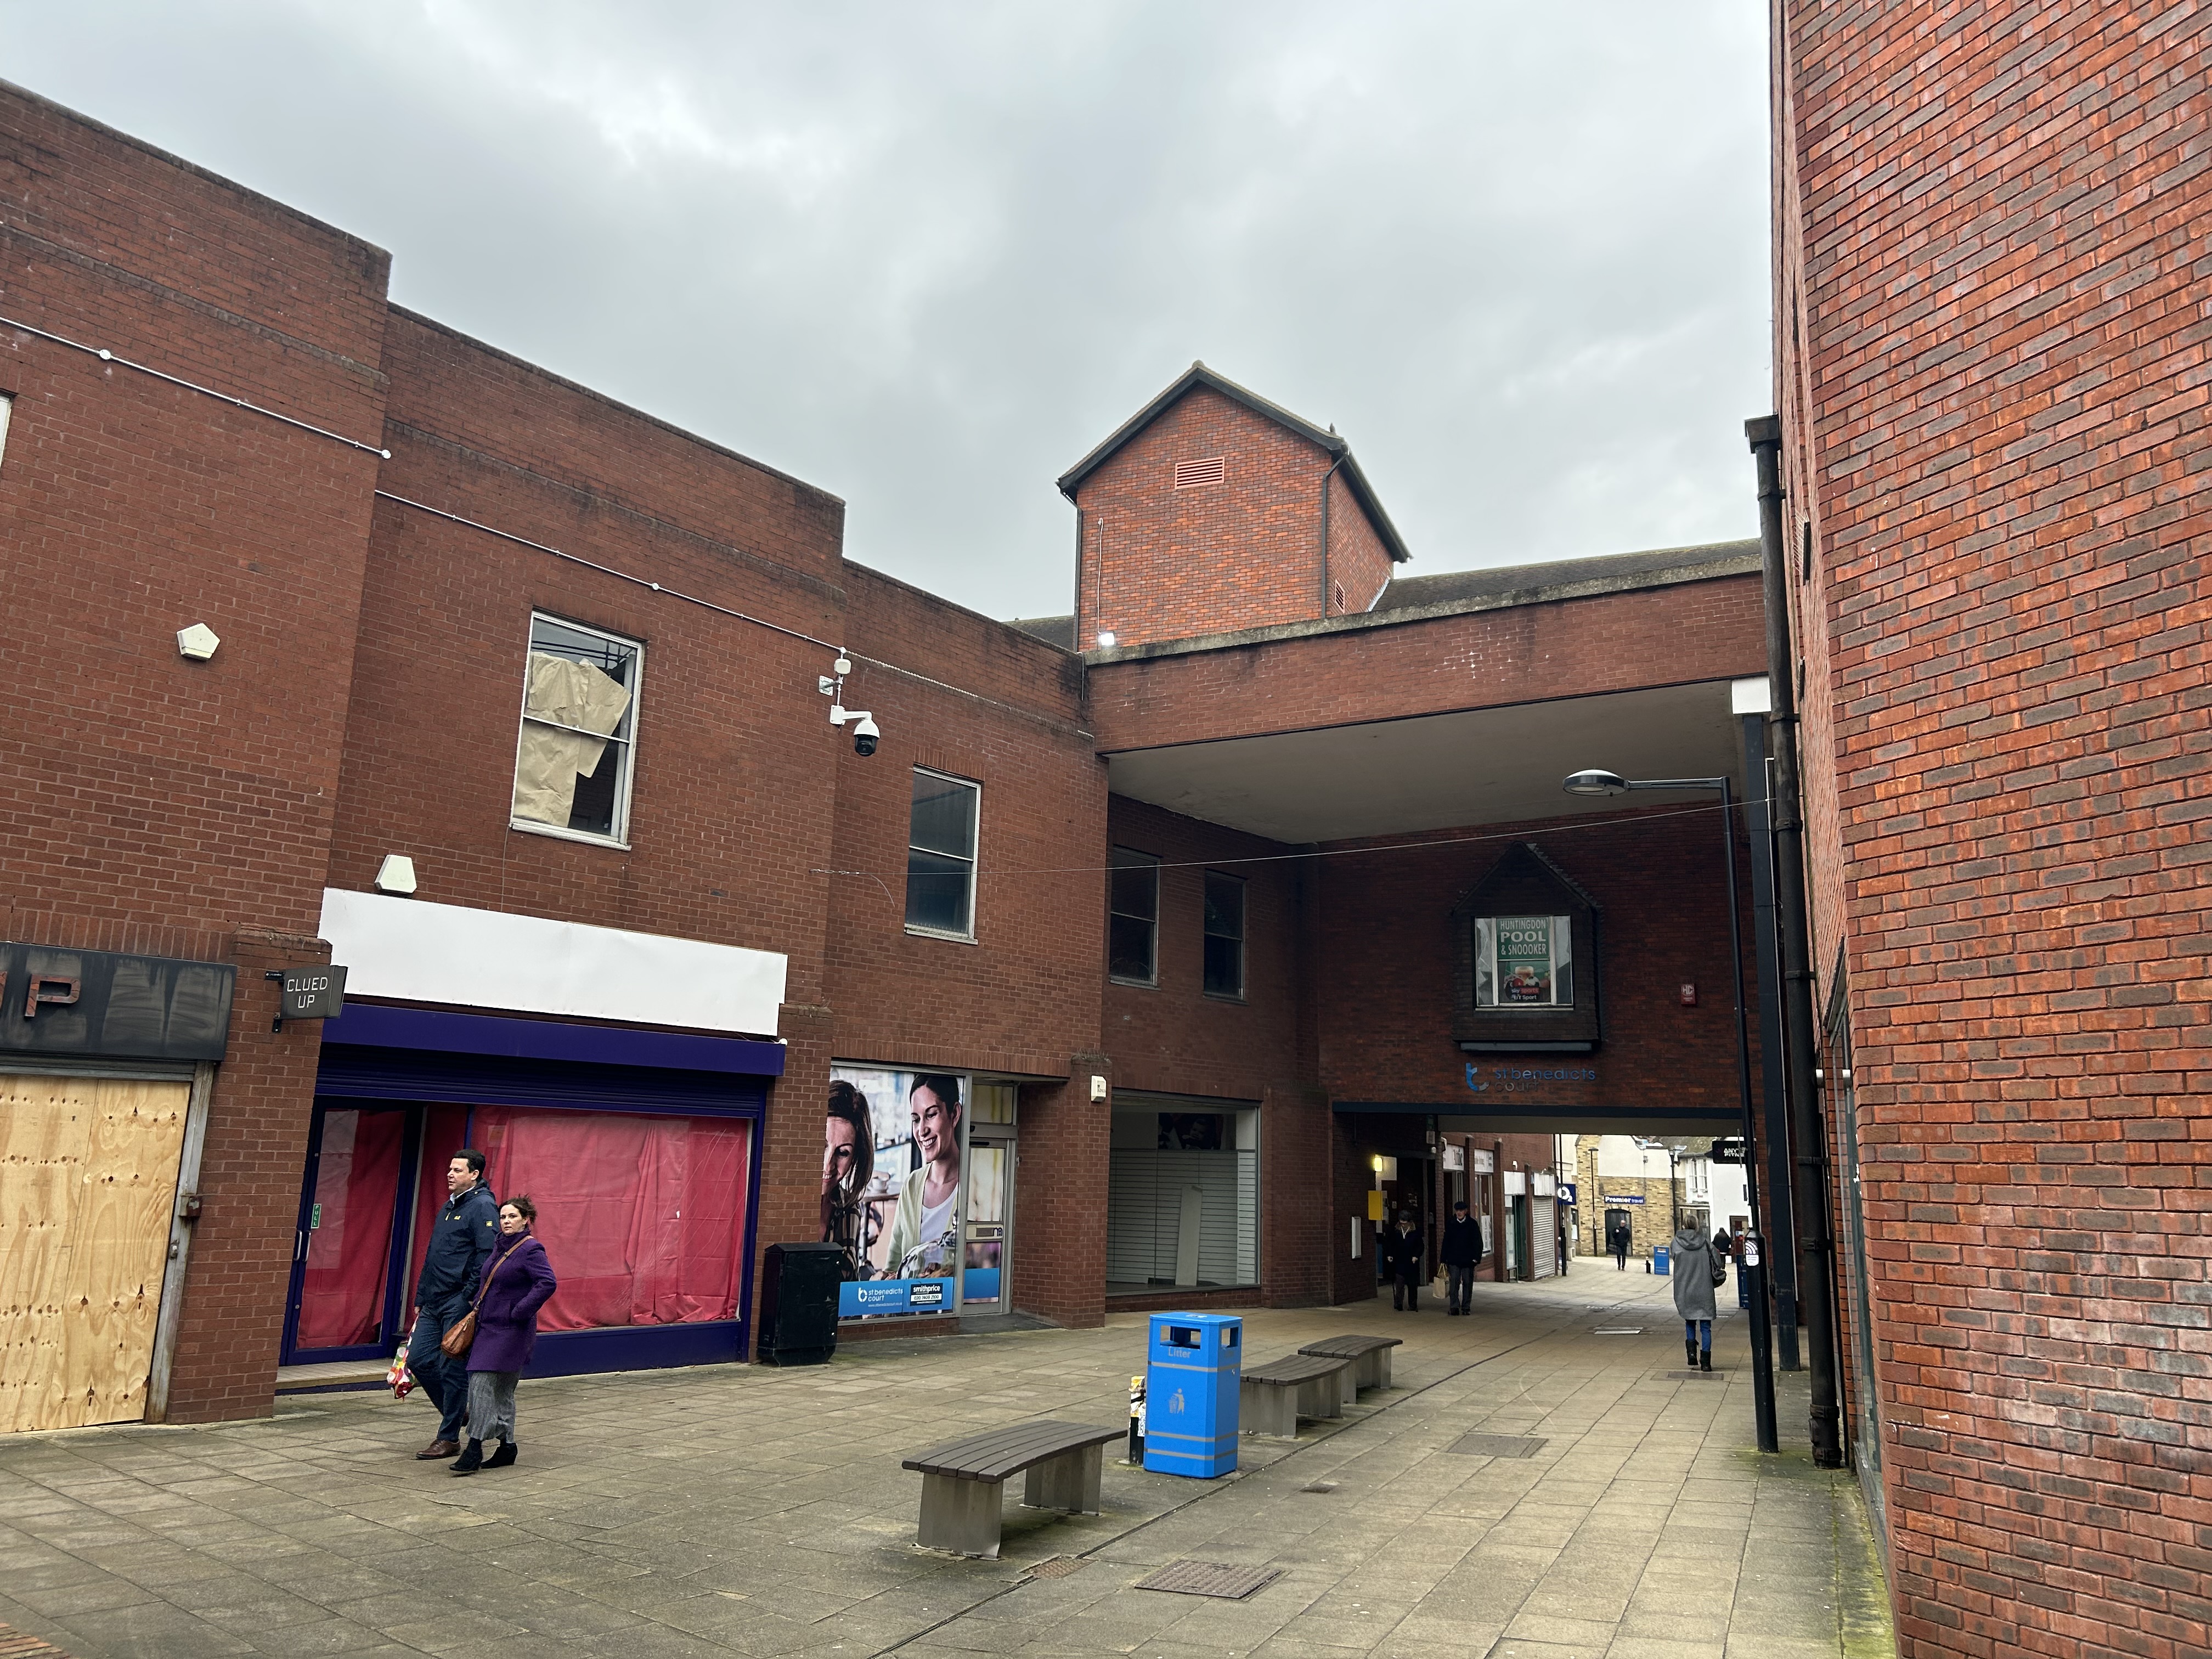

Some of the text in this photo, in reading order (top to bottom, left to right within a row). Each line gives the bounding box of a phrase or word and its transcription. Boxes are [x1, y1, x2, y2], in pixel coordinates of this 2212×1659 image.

[1500, 919, 1546, 930] HUNTINGDON
[1500, 931, 1547, 943] POOL
[1501, 944, 1547, 955] & SNOOOKER
[287, 977, 328, 992] CLUED
[298, 995, 315, 1008] UP
[1494, 1067, 1596, 1081] st benedicts
[1494, 1081, 1539, 1092] court
[913, 1285, 941, 1294] smithprice
[1169, 1348, 1191, 1358] Litter
